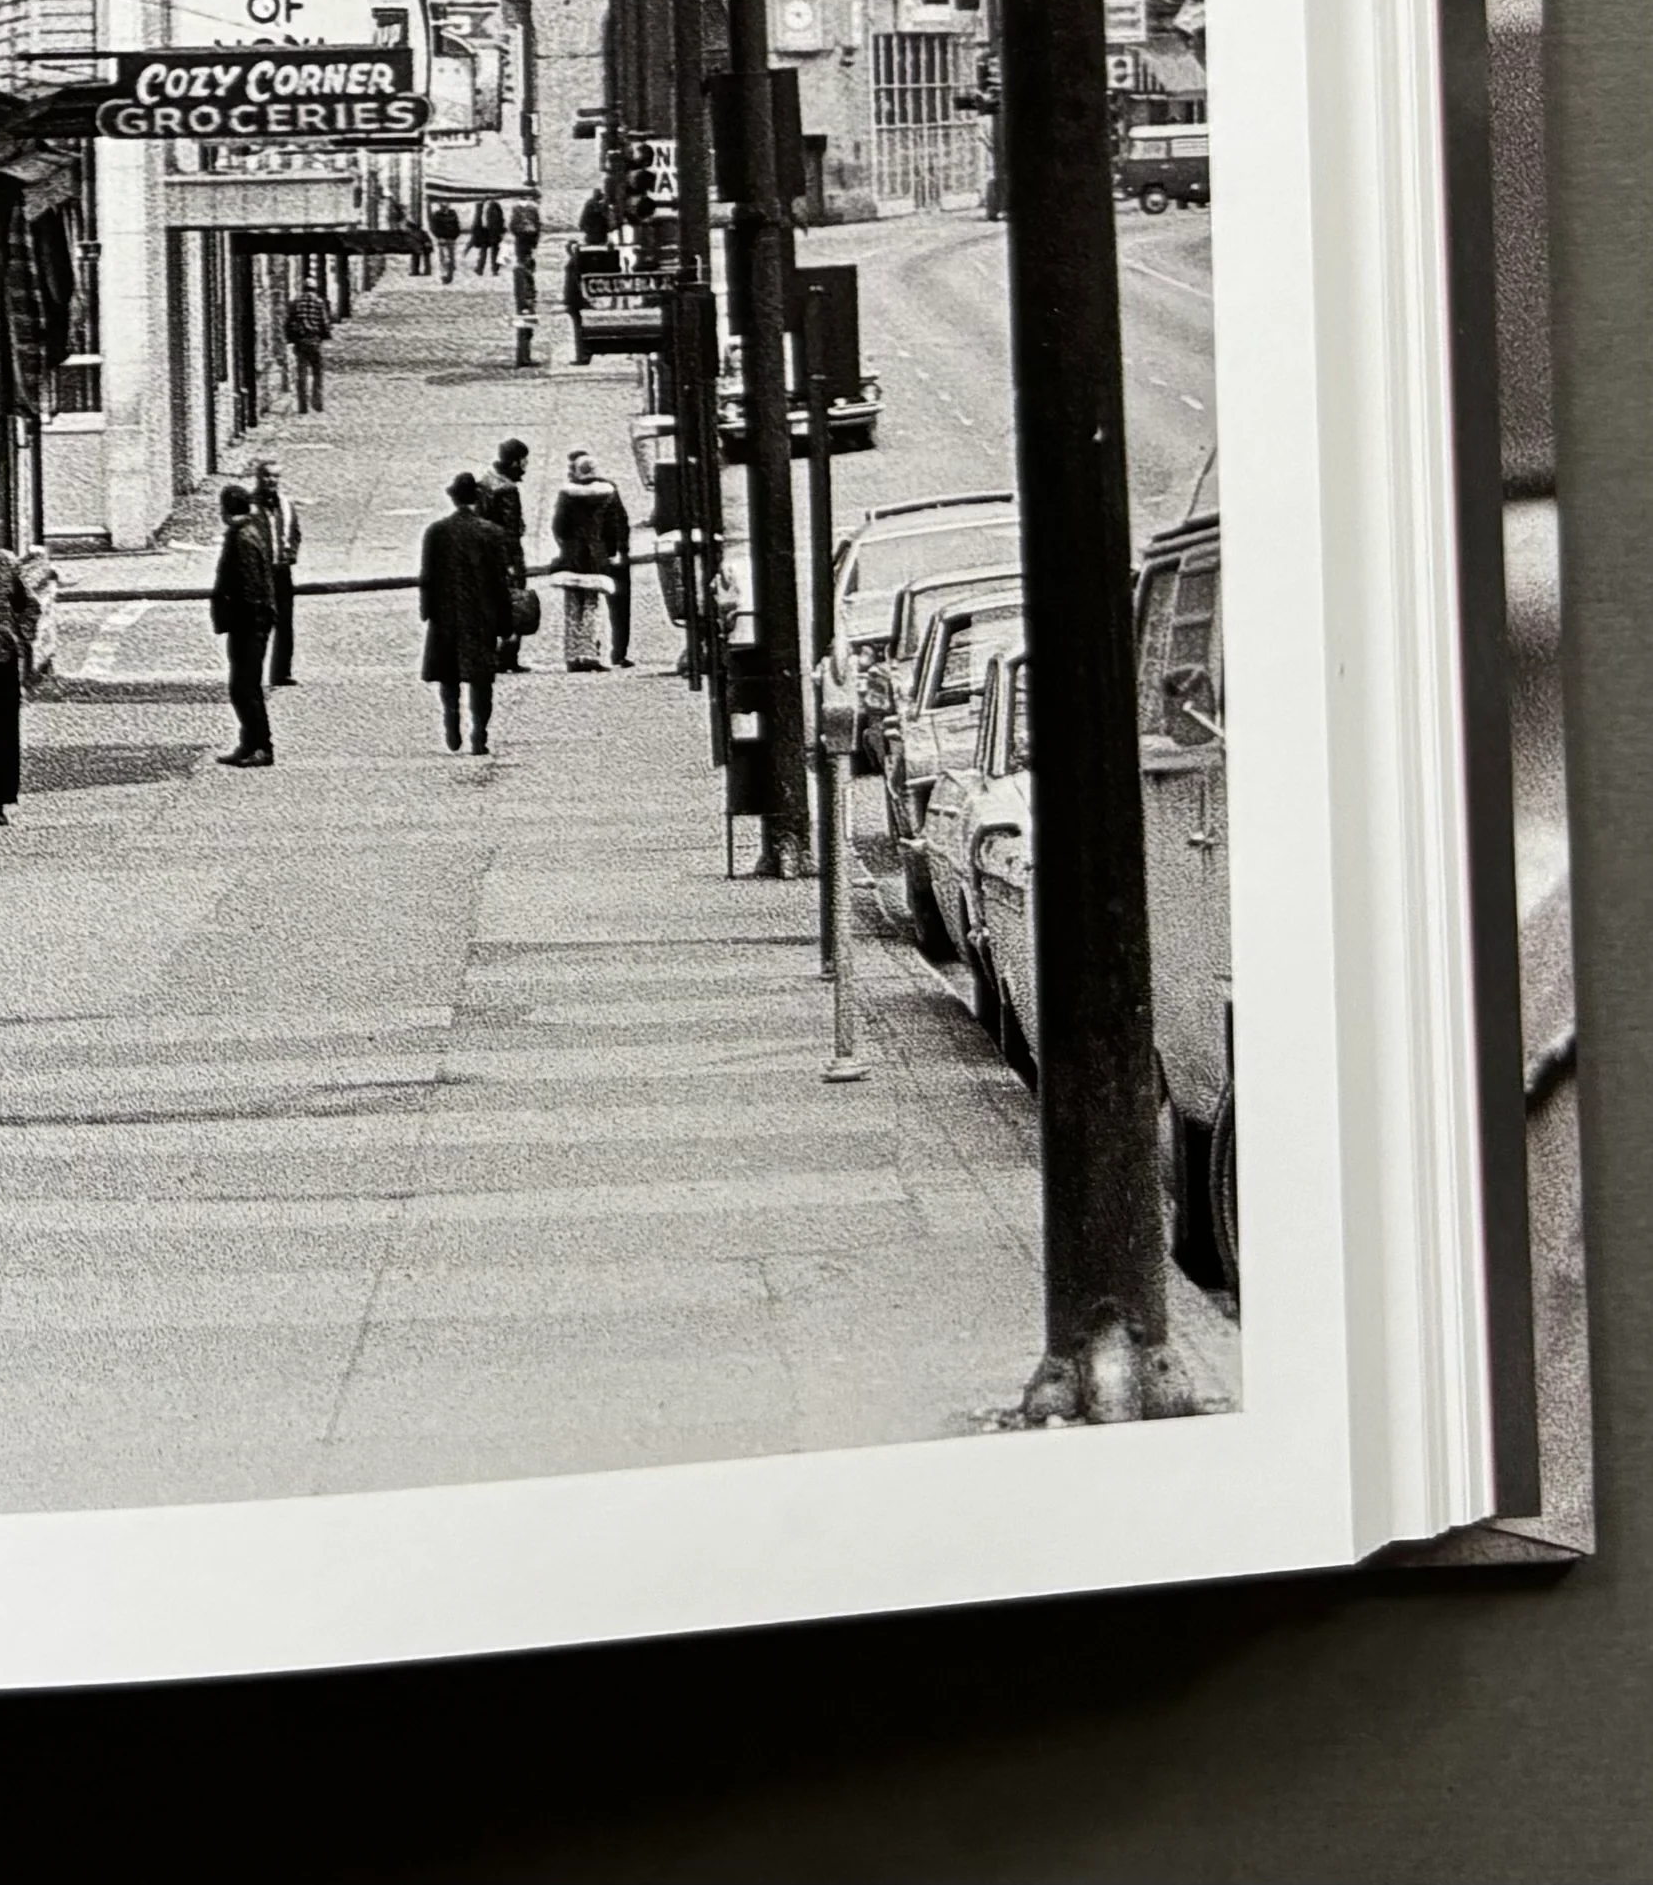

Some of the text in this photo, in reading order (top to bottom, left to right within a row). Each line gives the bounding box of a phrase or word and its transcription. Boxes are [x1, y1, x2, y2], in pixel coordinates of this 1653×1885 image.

[136, 60, 396, 105] COZY CORNER
[115, 101, 417, 135] GROCERIES
